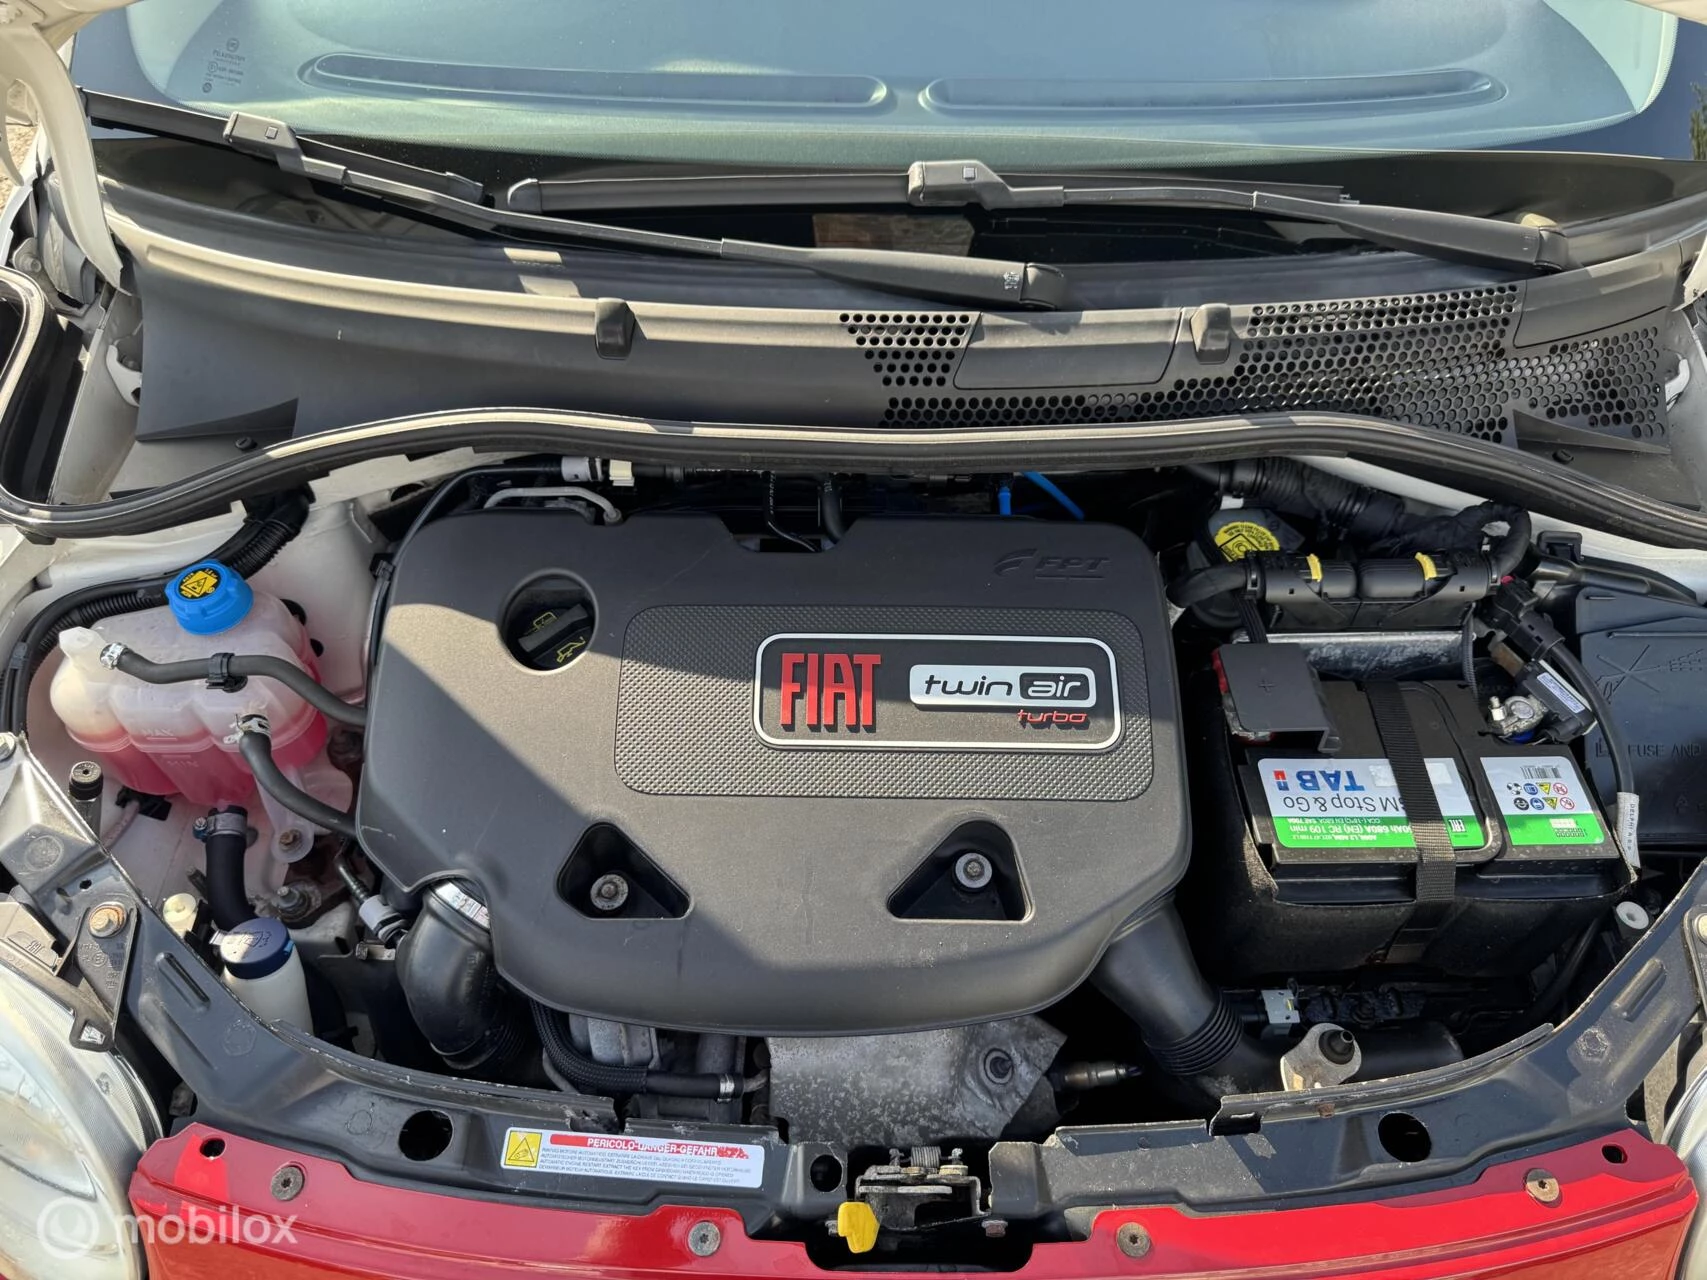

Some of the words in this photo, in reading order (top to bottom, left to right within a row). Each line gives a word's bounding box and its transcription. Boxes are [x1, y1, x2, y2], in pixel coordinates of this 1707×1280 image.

[780, 652, 882, 726] FIAT
[924, 675, 1013, 697] twin
[1027, 675, 1081, 698] air
[1017, 709, 1087, 724] turbo
[1628, 743, 1665, 757] FUSE
[1296, 770, 1365, 791] TAB
[1283, 796, 1311, 812] Go
[1312, 796, 1328, 812] &
[1331, 793, 1377, 812] Stop
[1290, 824, 1308, 833] min
[1309, 825, 1326, 834] 109
[1328, 825, 1342, 834] RC
